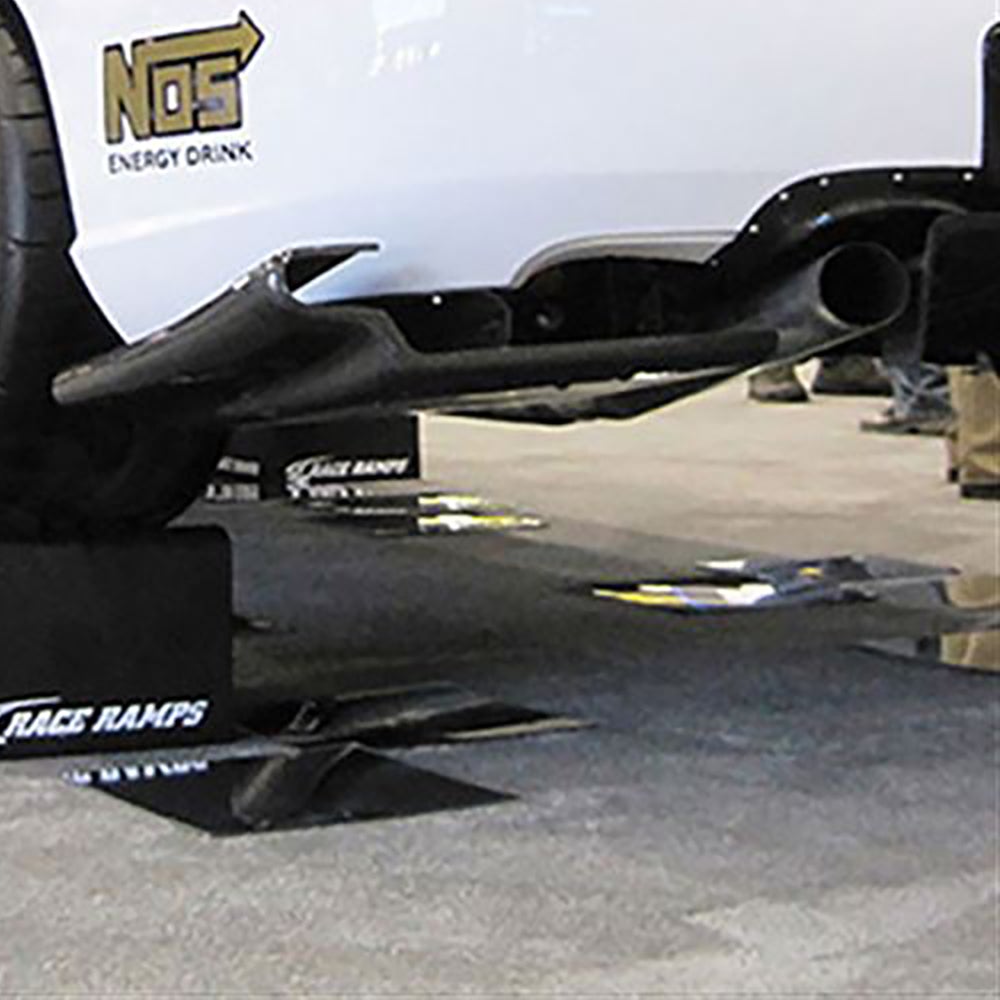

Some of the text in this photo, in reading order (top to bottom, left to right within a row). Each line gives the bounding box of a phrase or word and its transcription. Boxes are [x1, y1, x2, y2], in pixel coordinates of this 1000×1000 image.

[103, 9, 265, 145] NOS
[108, 140, 252, 174] ENERGY DRINK
[3, 700, 210, 740] RACE RAMPS
